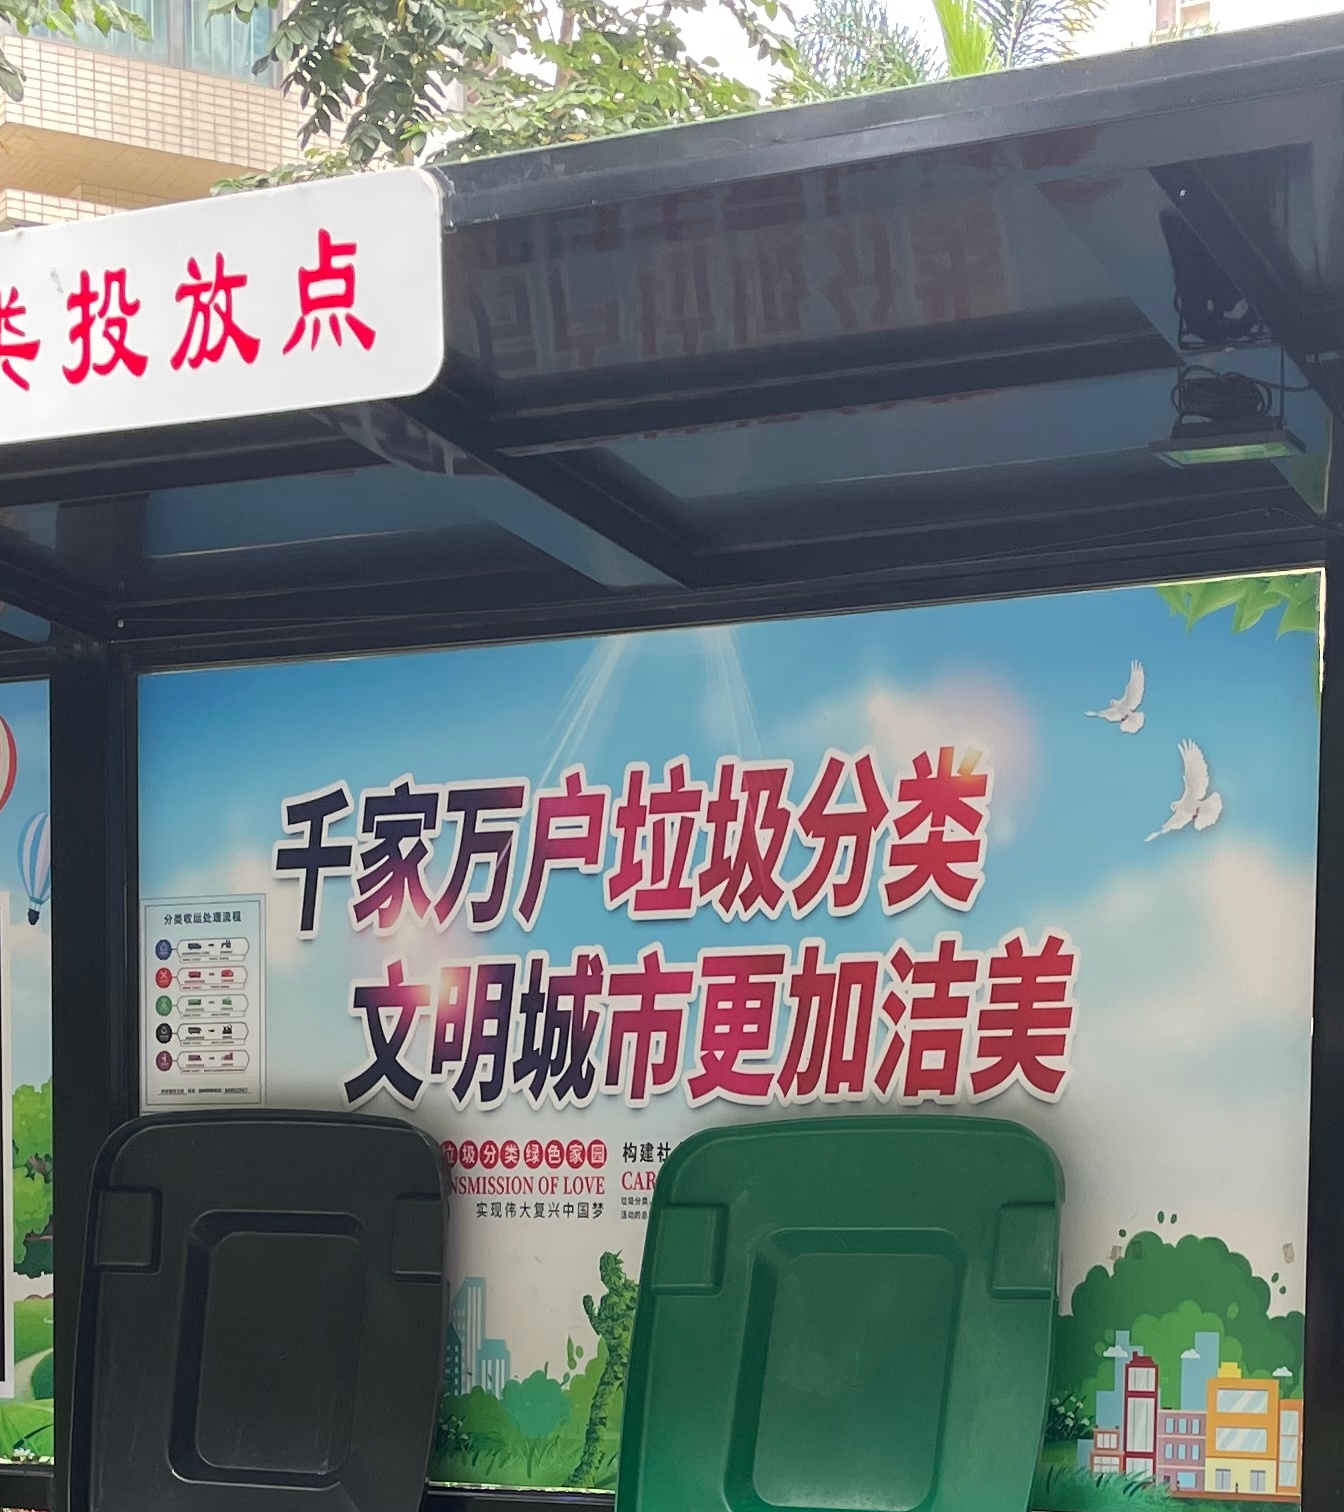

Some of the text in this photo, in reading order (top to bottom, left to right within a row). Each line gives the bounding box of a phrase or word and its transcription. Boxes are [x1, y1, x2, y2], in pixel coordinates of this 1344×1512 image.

[274, 743, 990, 938] 千家万户垃圾分类
[164, 911, 242, 926] 分类收运处理流程
[342, 928, 1080, 1109] 文明城市更加洁美
[538, 1176, 559, 1194] OF
[563, 1176, 605, 1195] LOVE
[476, 1201, 605, 1220] 实现伟大复兴中国梦
